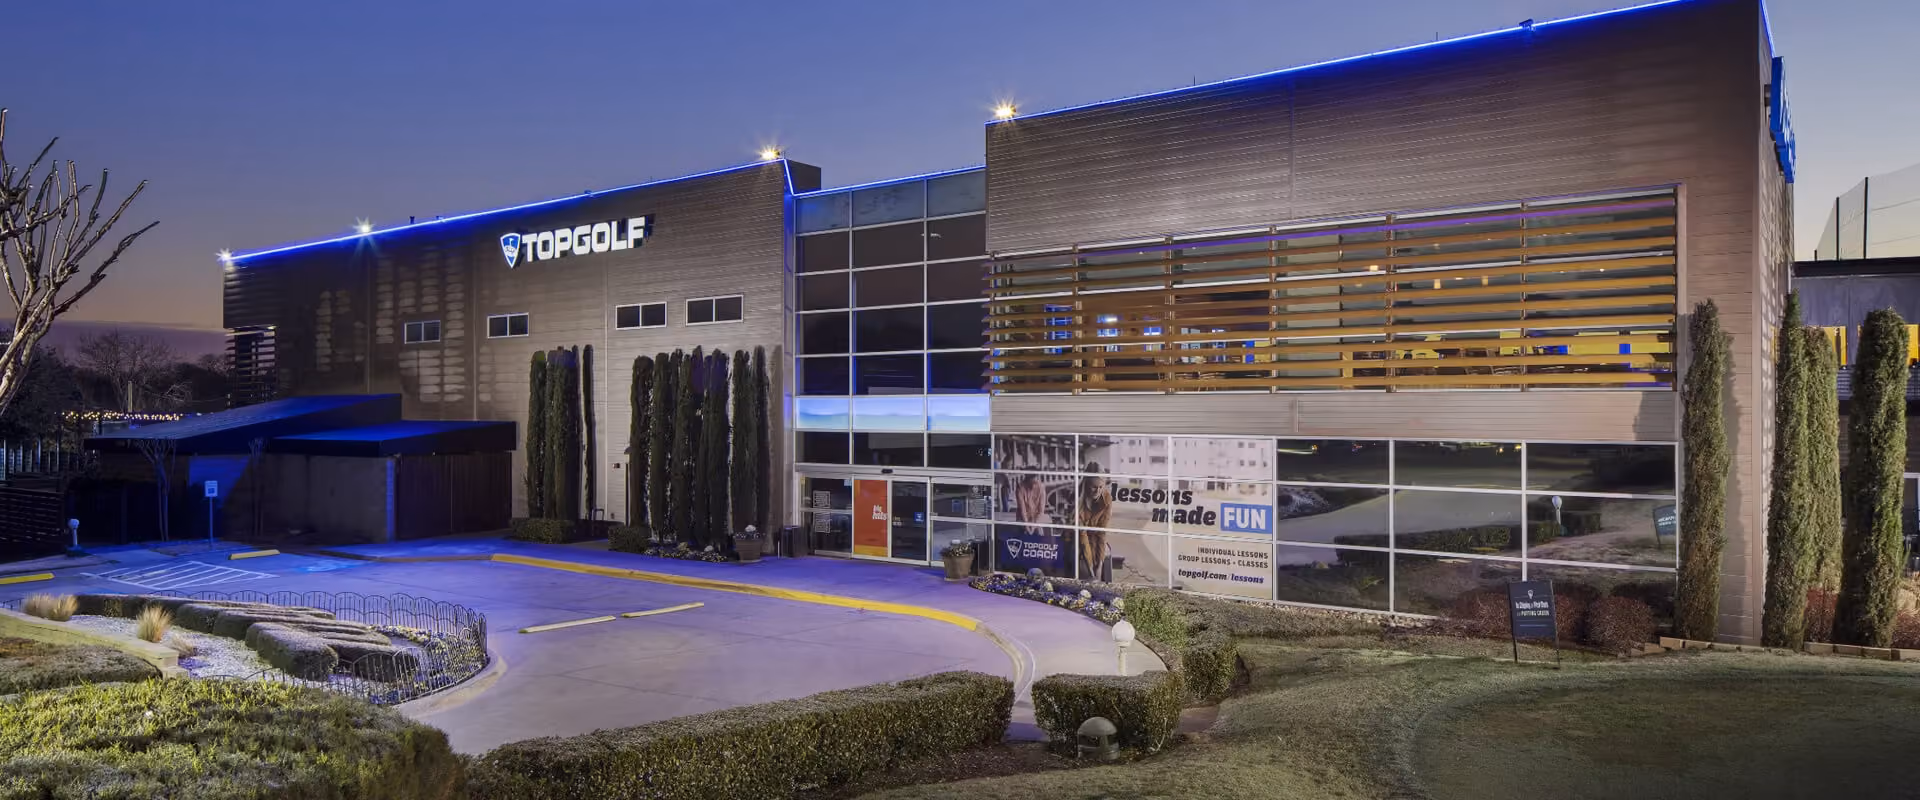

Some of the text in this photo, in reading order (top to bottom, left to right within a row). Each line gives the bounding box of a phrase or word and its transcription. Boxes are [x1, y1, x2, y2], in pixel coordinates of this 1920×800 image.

[522, 216, 646, 262] TOPGOLF
[1111, 483, 1193, 506] lessons
[1151, 506, 1267, 530] made FUN
[1024, 542, 1058, 550] TOPGOLF
[1197, 546, 1269, 559] INDIVIDUAL LESSONS
[1023, 550, 1058, 559] COACH
[1177, 554, 1269, 569] GROUP LESSONS CLASSES
